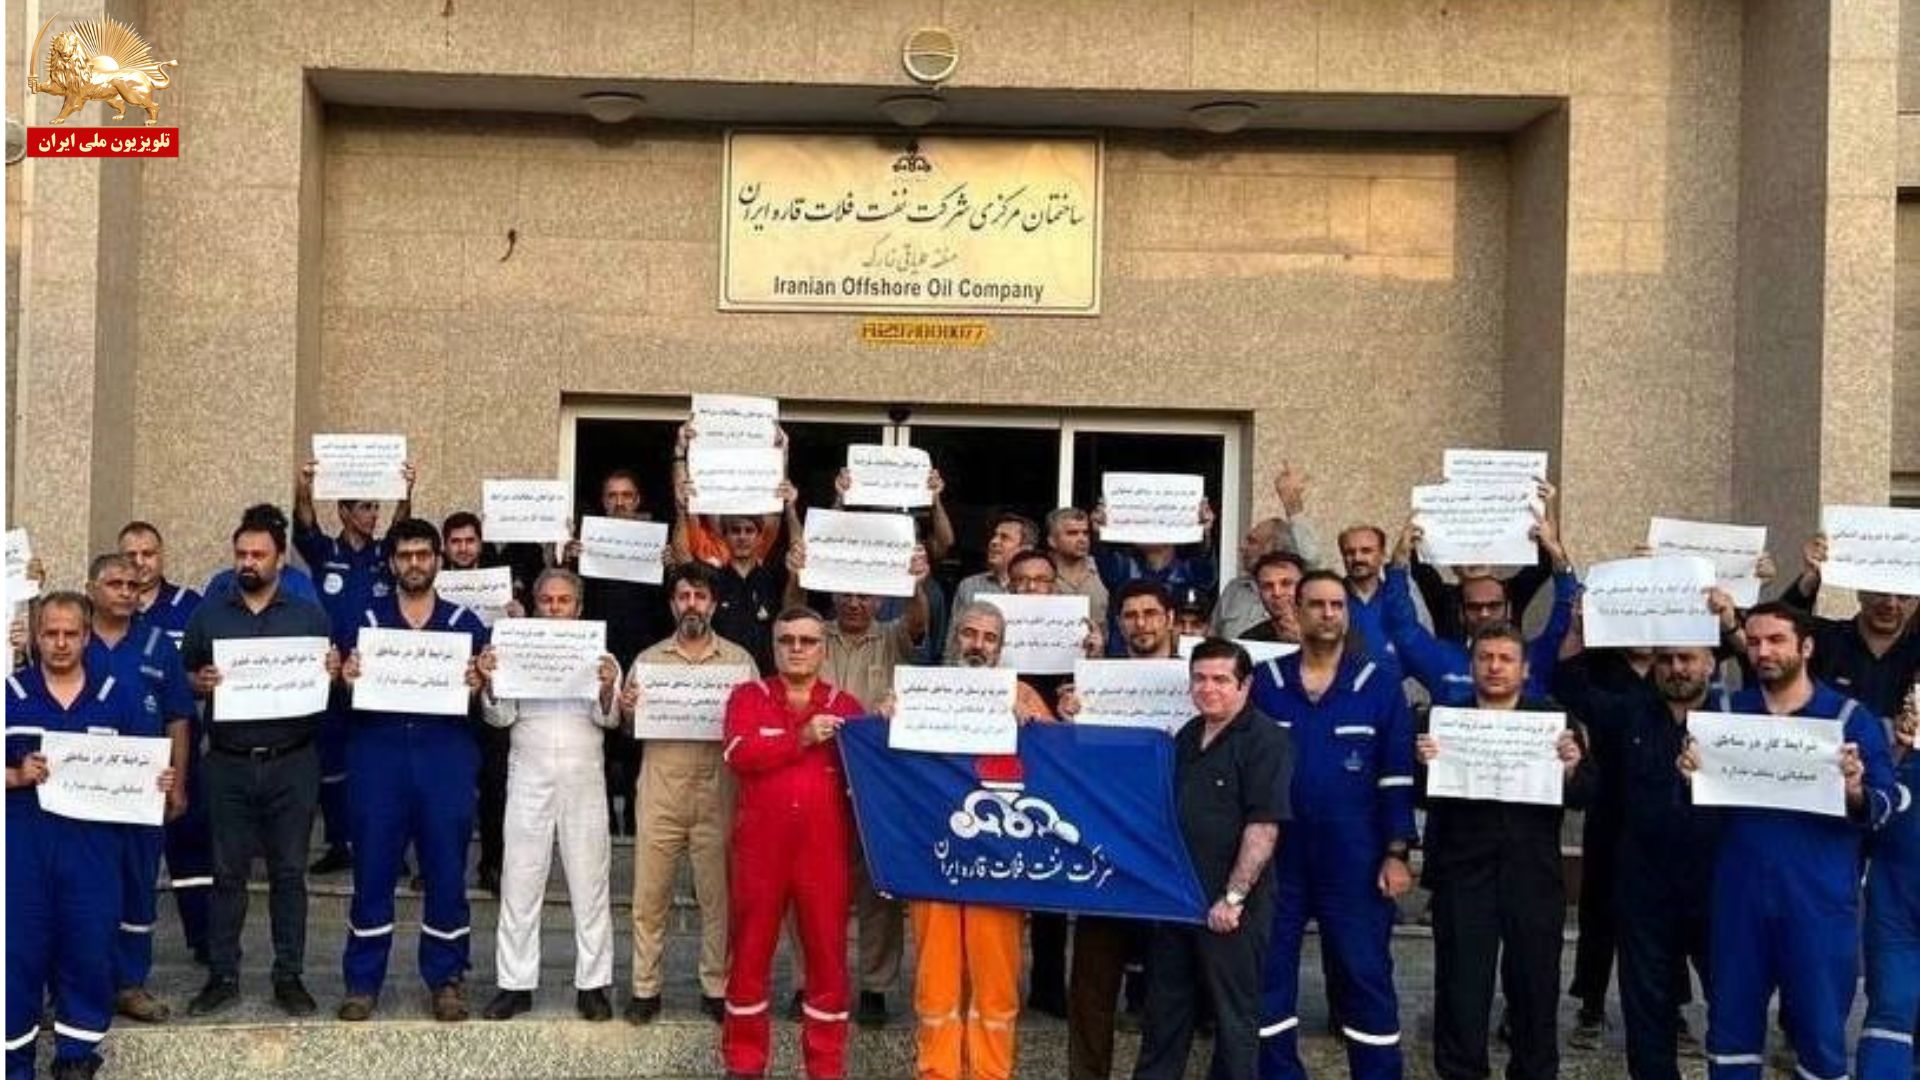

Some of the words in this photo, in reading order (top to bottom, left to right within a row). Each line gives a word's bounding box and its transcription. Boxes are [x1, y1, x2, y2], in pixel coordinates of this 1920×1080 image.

[738, 181, 771, 232] ایران
[804, 191, 855, 222] فلات
[856, 186, 908, 221] نفت
[907, 181, 971, 228] شرکت
[969, 185, 1028, 230] مرکزی
[1021, 190, 1085, 232] ساختمان
[774, 275, 836, 296] Iranian
[841, 275, 921, 297] Offshore
[928, 276, 952, 298] Oil
[959, 277, 1044, 303] Company
[934, 838, 960, 885] ایران
[989, 851, 1025, 880] فلات
[1027, 846, 1063, 880] نفت
[1066, 843, 1114, 889] شرکت
